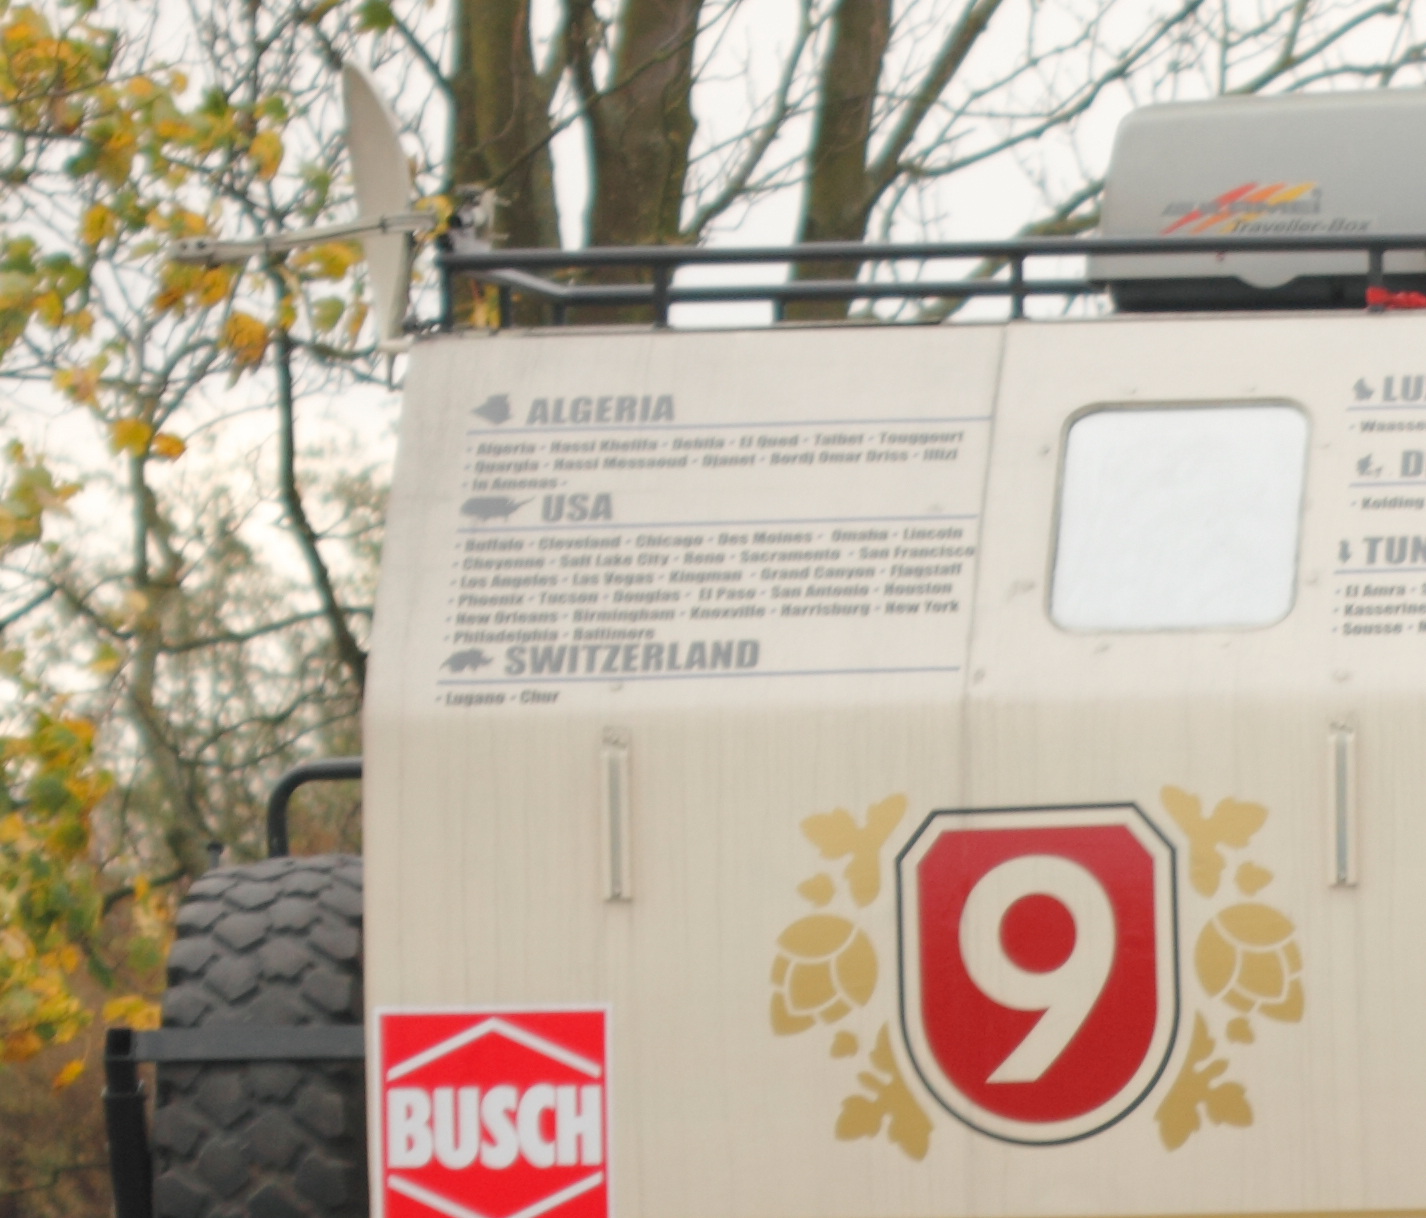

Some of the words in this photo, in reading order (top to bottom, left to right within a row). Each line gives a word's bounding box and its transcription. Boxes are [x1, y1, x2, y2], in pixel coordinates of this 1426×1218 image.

[525, 394, 674, 425] ALGERIA
[541, 494, 612, 523] USA
[504, 640, 759, 675] SWITZERLAND
[958, 853, 1117, 1084] 9
[387, 1083, 603, 1171] BUSCH
